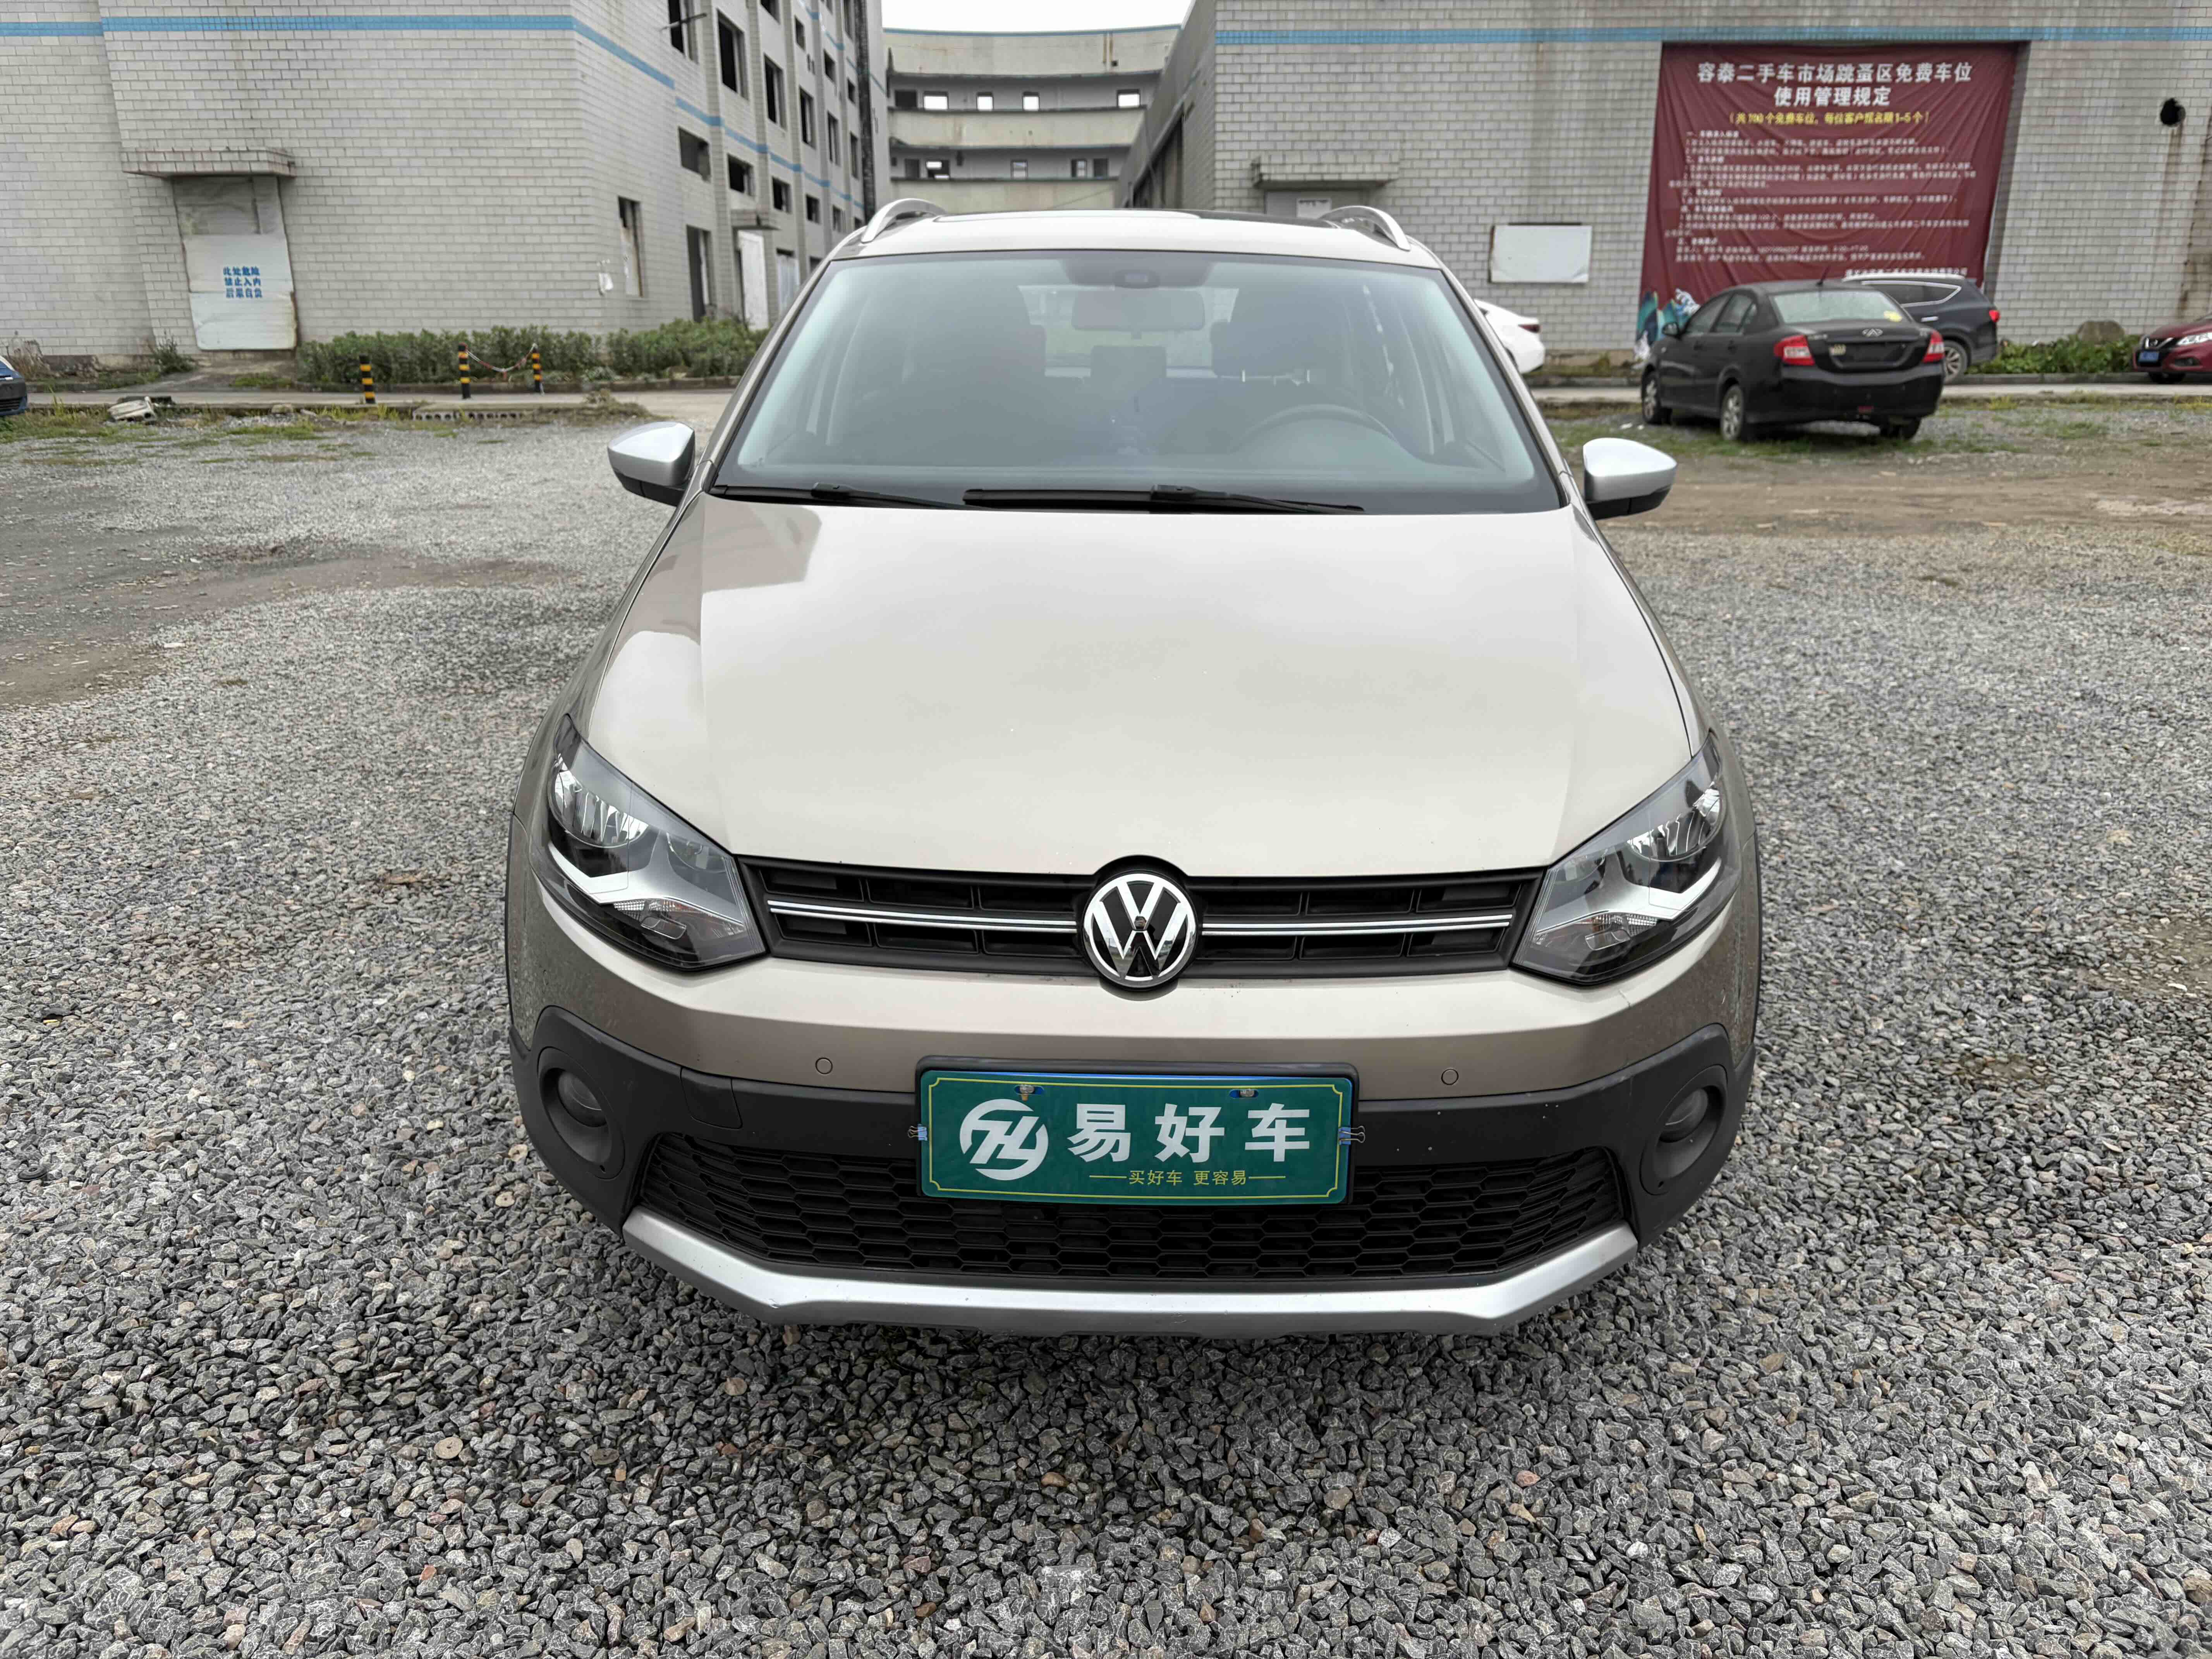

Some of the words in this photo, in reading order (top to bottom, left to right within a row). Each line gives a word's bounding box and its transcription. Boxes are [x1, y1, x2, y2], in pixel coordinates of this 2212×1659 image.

[1697, 62, 1972, 83] 容泰二手车市场跳蚤区免费车位
[1774, 86, 1891, 106] 使用管理规定
[223, 266, 260, 276] 此处危险
[224, 277, 261, 287] 禁止入内
[226, 288, 263, 299] 后果自负
[1068, 1103, 1310, 1163] 易好车
[1129, 1170, 1182, 1186] 买好车
[1193, 1170, 1247, 1185] 更容易
